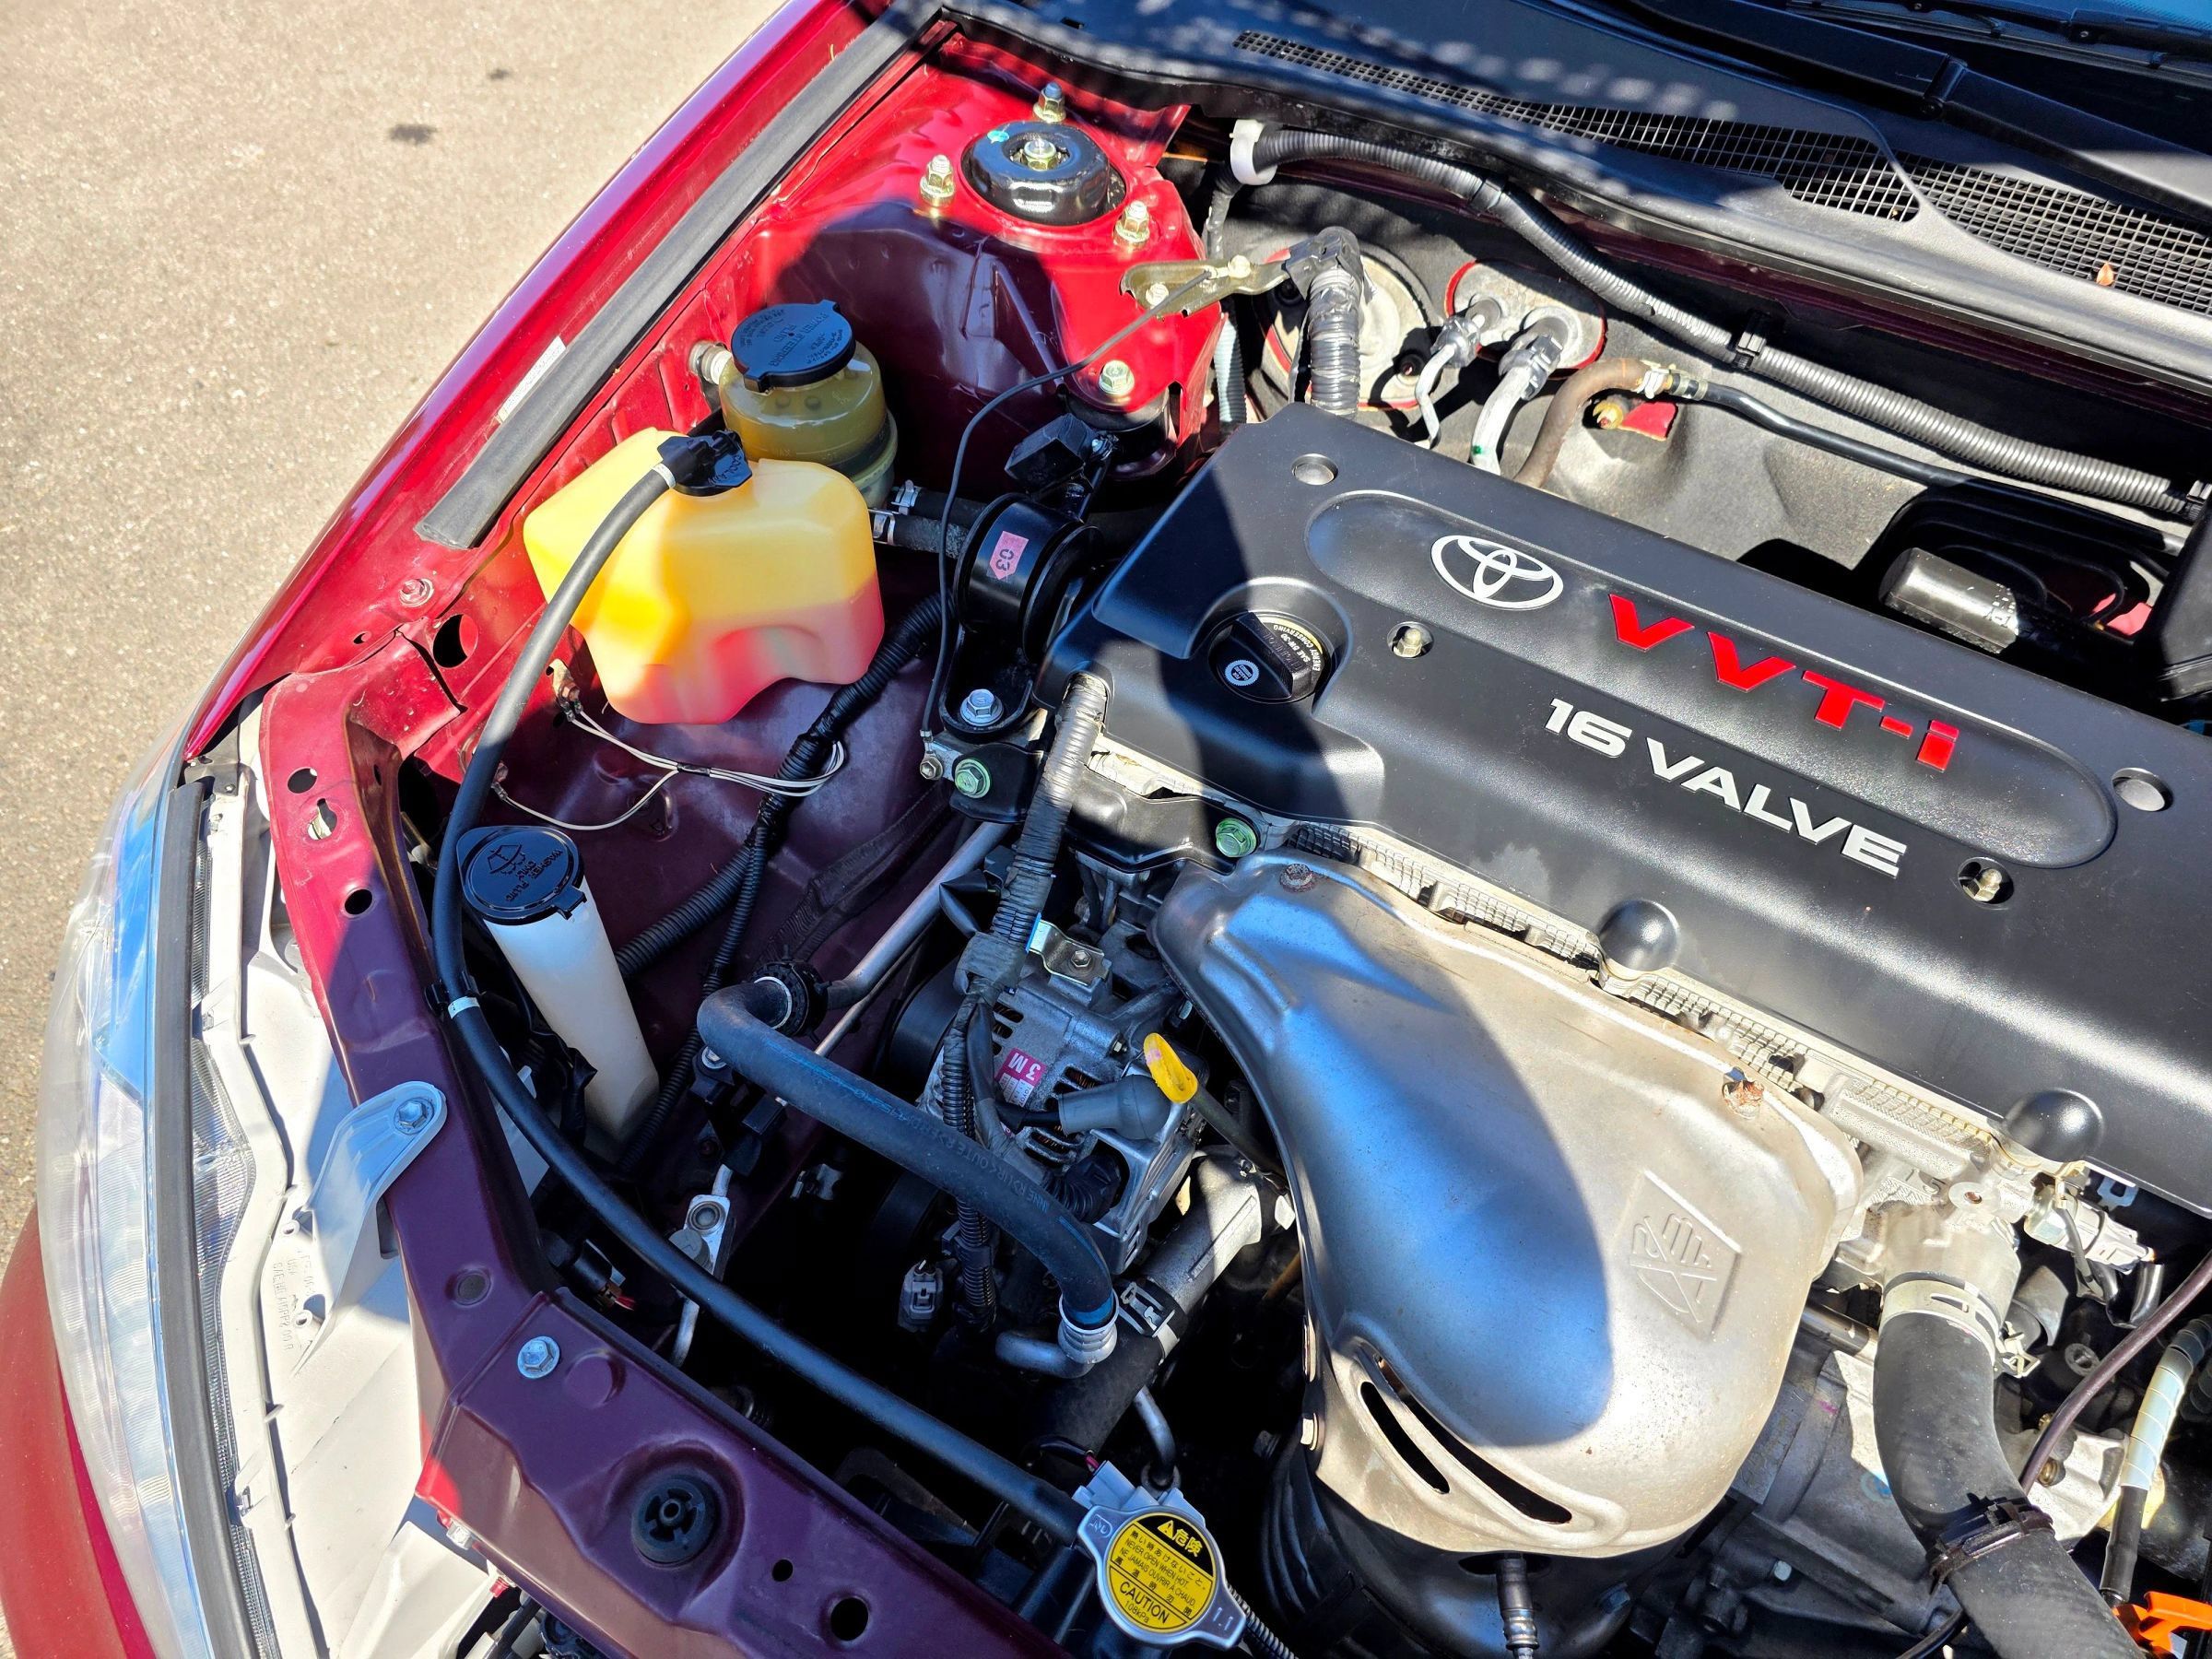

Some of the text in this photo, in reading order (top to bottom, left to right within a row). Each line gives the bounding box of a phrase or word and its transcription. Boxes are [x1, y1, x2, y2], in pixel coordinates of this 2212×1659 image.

[1273, 624, 1313, 649] CONSERVING
[1296, 649, 1311, 663] SAE
[1608, 593, 1959, 771] VVT-i
[1545, 698, 1908, 878] 16 VALVE
[530, 849, 563, 878] WASHER
[1124, 1537, 1145, 1557] NEVER
[1142, 1551, 1159, 1568] OPEN
[1158, 1563, 1176, 1580] WHEN
[1172, 1530, 1204, 1558] 危険
[1118, 1547, 1128, 1557] NE
[1126, 1552, 1149, 1572] JAMAIS
[1147, 1568, 1170, 1587] OUVRIR
[1120, 1582, 1170, 1623] CAUTION
[1124, 1601, 1149, 1623] 108kPa
